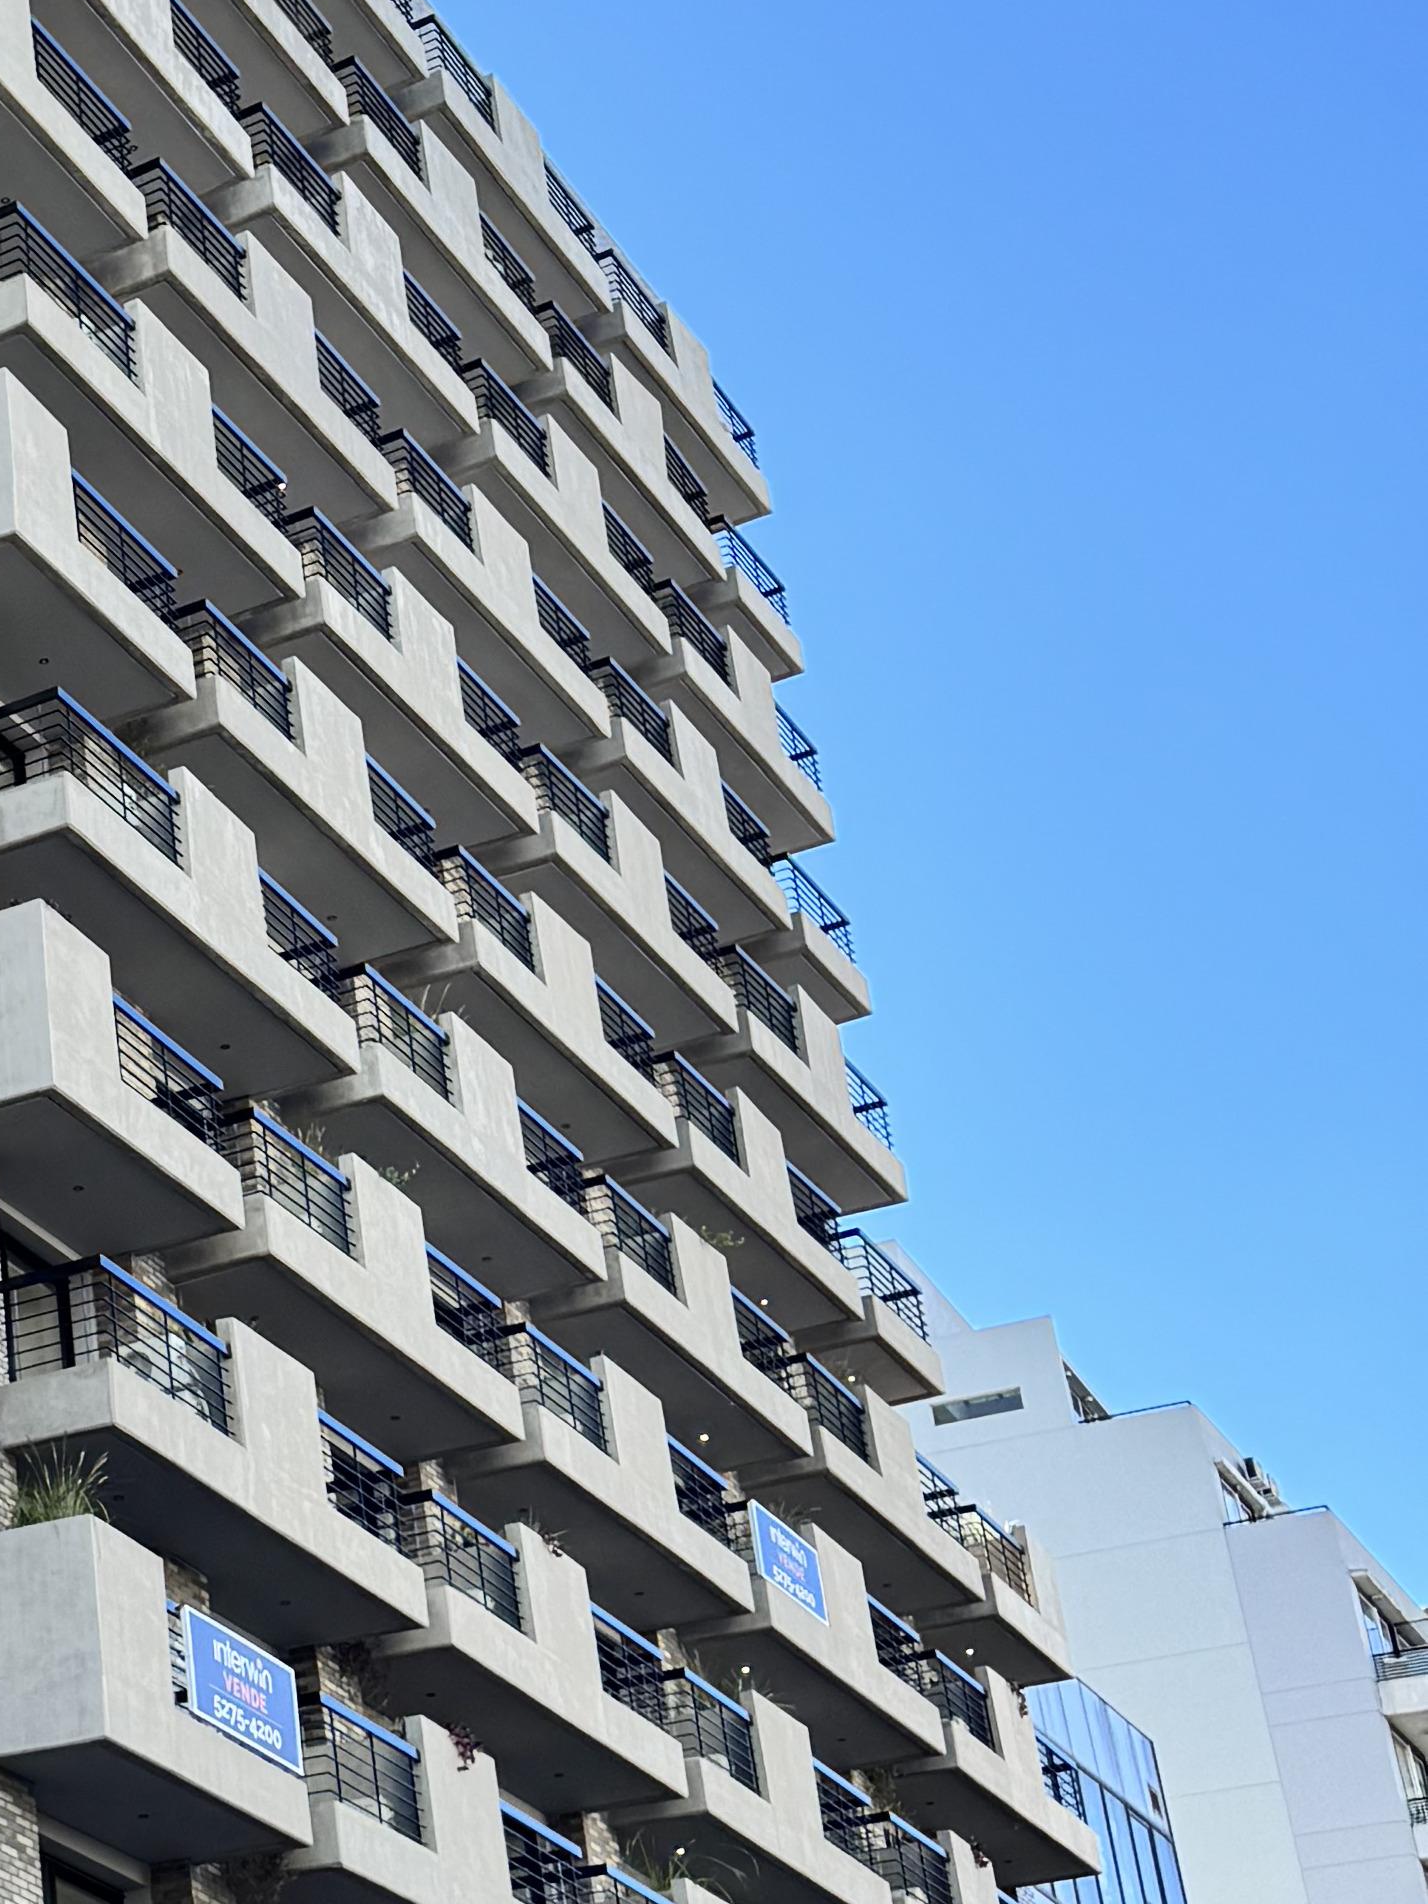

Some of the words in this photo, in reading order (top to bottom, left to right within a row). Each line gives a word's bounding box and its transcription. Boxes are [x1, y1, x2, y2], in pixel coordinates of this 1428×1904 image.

[213, 1638, 273, 1694] interwin
[223, 1671, 269, 1715] VENDE
[213, 1694, 283, 1751] 5275-4200
